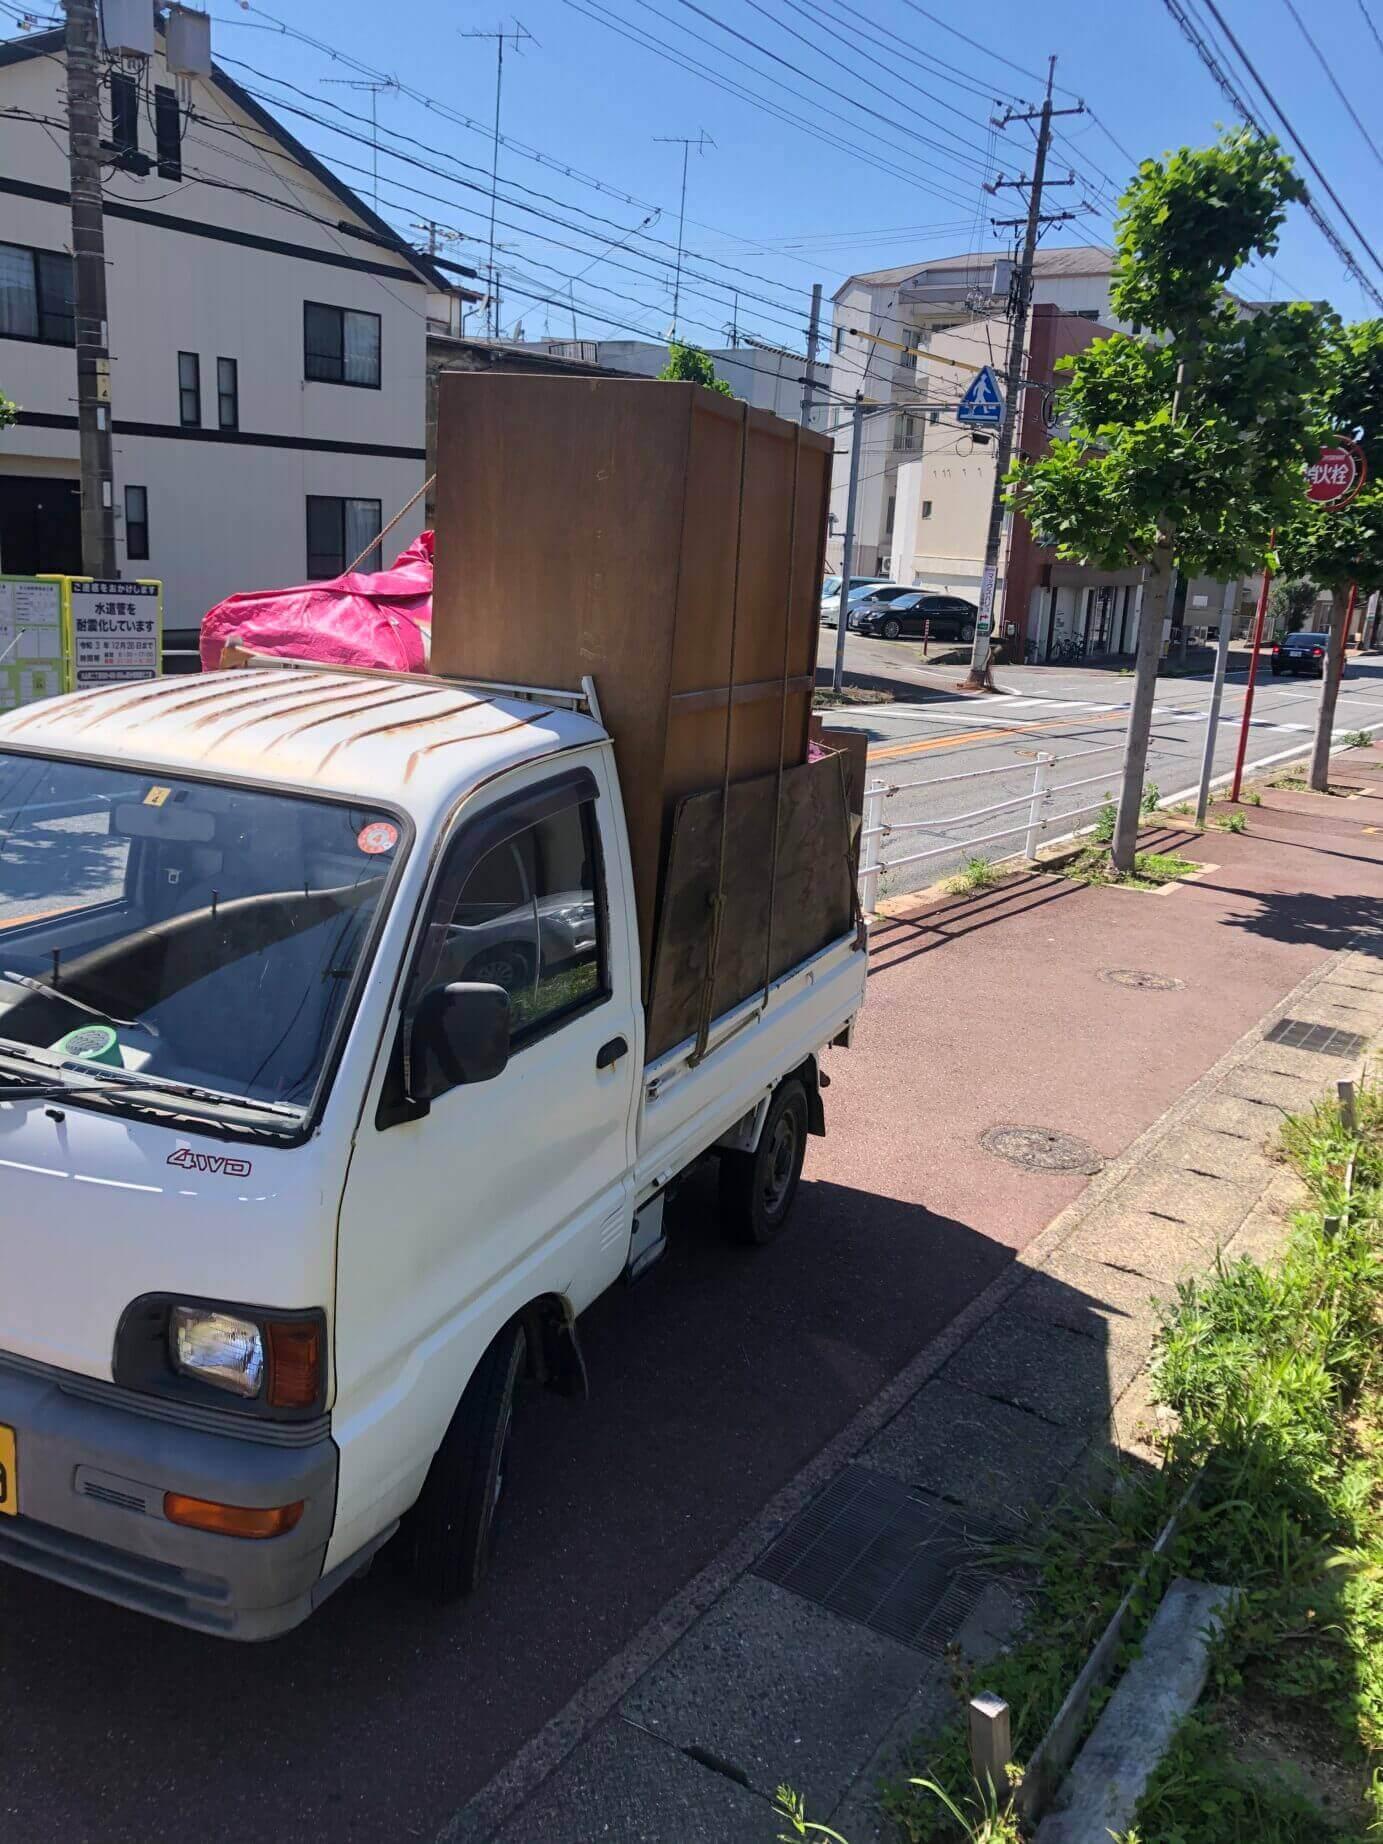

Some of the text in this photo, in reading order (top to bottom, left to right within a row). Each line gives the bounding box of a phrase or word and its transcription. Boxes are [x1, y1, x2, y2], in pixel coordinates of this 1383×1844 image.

[94, 602, 136, 616] 水道管を
[76, 618, 155, 633] 耐震化しています
[166, 1148, 252, 1177] 4WD
